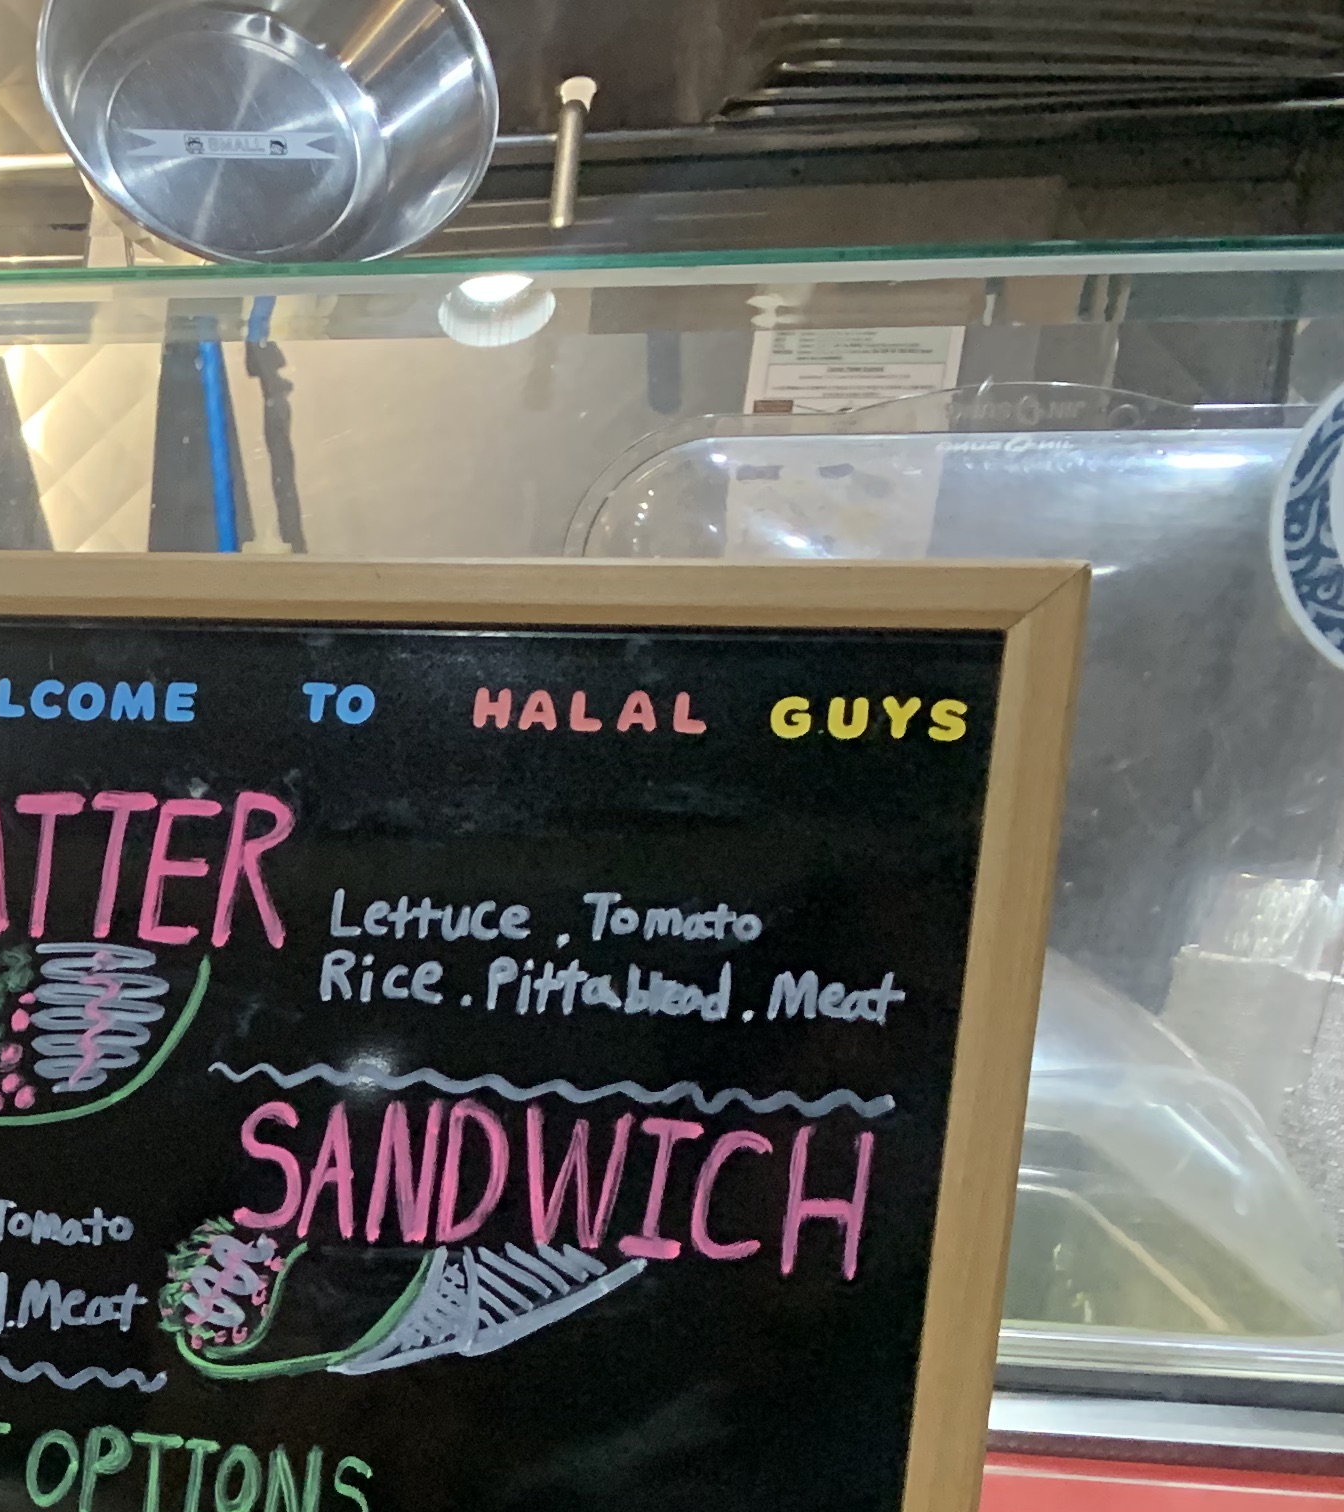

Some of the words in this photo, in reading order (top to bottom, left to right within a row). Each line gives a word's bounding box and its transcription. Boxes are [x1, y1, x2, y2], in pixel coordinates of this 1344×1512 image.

[302, 681, 377, 727] TO
[473, 687, 707, 734] HALAL
[770, 696, 969, 742] GUYS
[766, 970, 906, 1025] Meat
[234, 1098, 875, 1282] SANDWICH
